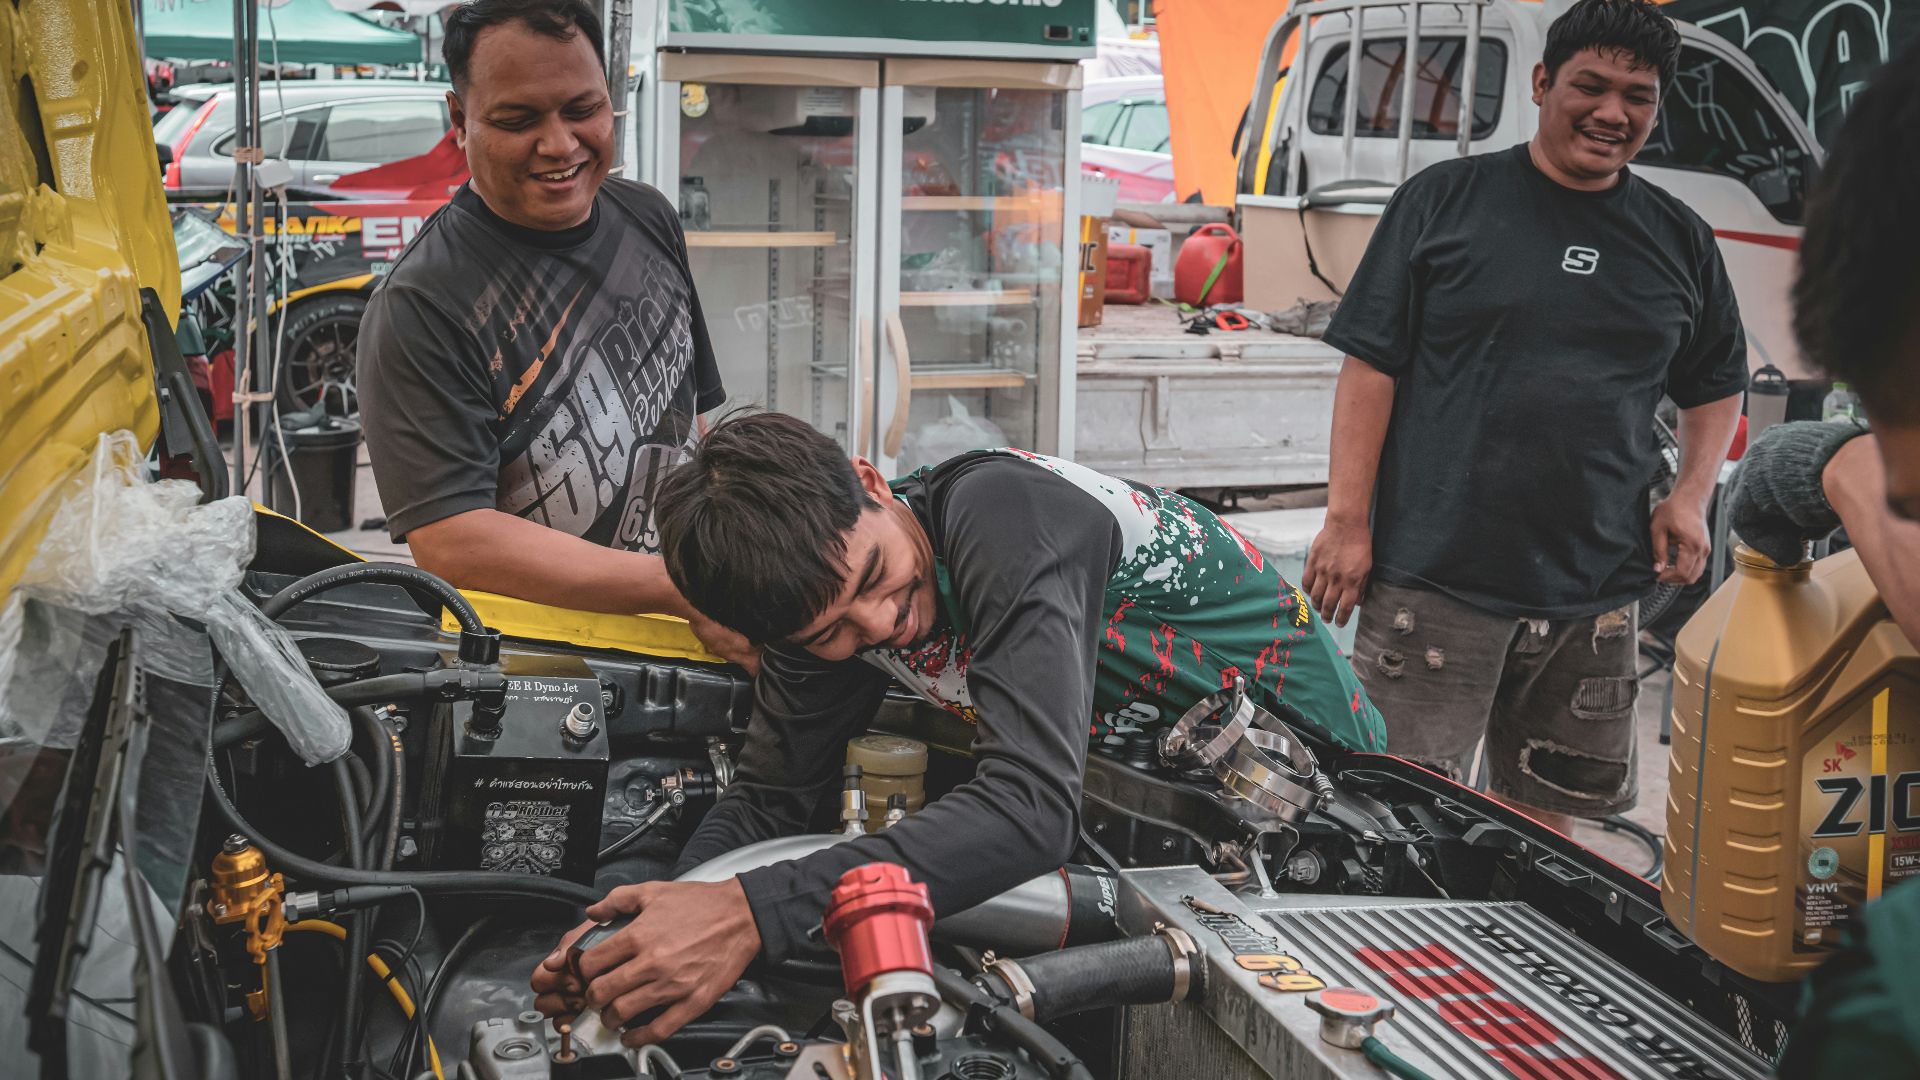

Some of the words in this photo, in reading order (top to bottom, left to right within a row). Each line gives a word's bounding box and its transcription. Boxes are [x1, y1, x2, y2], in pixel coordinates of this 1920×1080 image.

[1561, 246, 1600, 275] S
[523, 681, 533, 691] R
[534, 681, 561, 694] Dyno
[562, 683, 579, 693] Jet
[1823, 759, 1842, 773] SK
